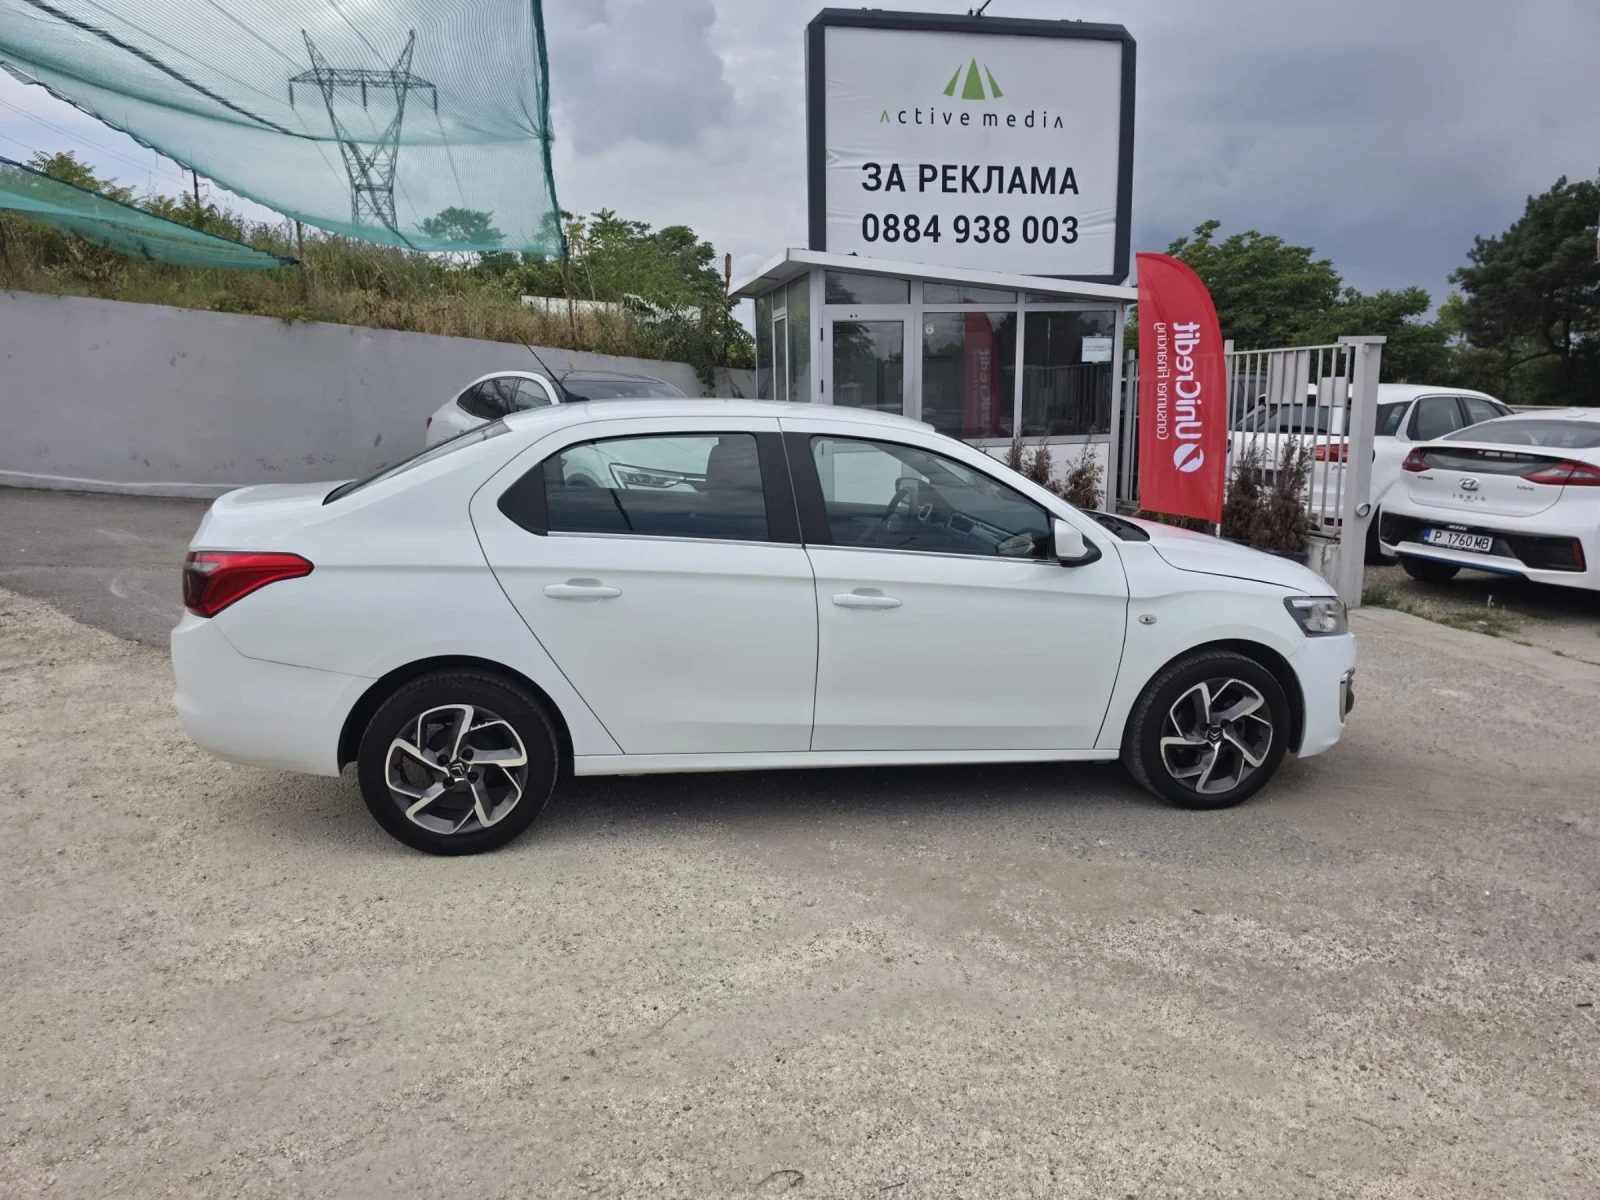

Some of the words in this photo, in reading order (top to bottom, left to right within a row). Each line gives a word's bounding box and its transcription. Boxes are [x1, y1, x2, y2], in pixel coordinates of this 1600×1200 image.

[861, 163, 906, 192] ЗА
[918, 164, 1080, 195] РЕКЛАМА
[862, 213, 941, 243] 0884
[953, 215, 1010, 244] 938
[1022, 216, 1079, 244] 003
